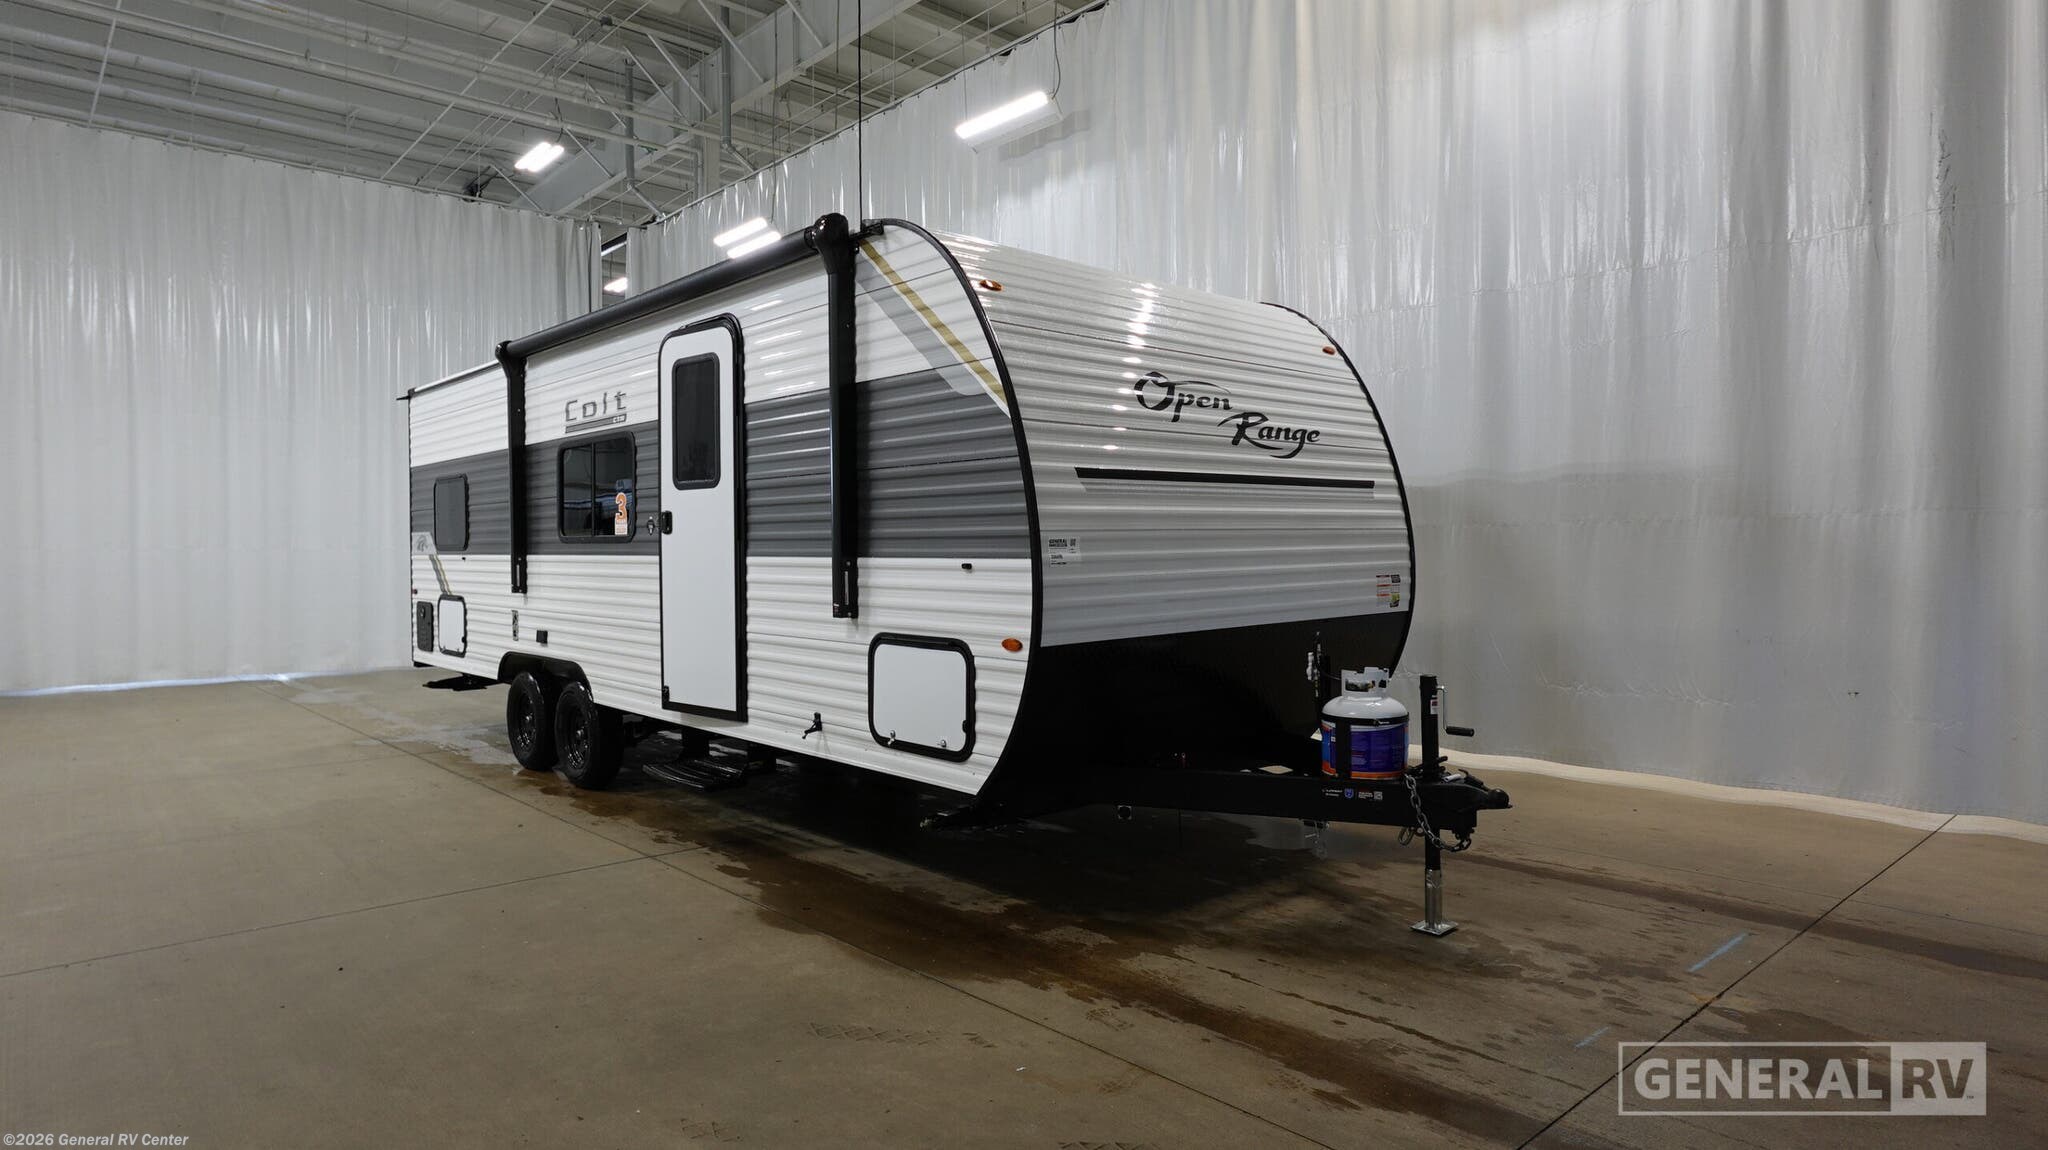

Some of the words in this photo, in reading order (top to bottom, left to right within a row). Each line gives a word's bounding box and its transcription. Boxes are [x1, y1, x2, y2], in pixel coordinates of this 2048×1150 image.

[565, 391, 627, 421] Colt
[1133, 371, 1233, 423] Open
[1217, 411, 1321, 459] Range
[615, 492, 627, 520] 3
